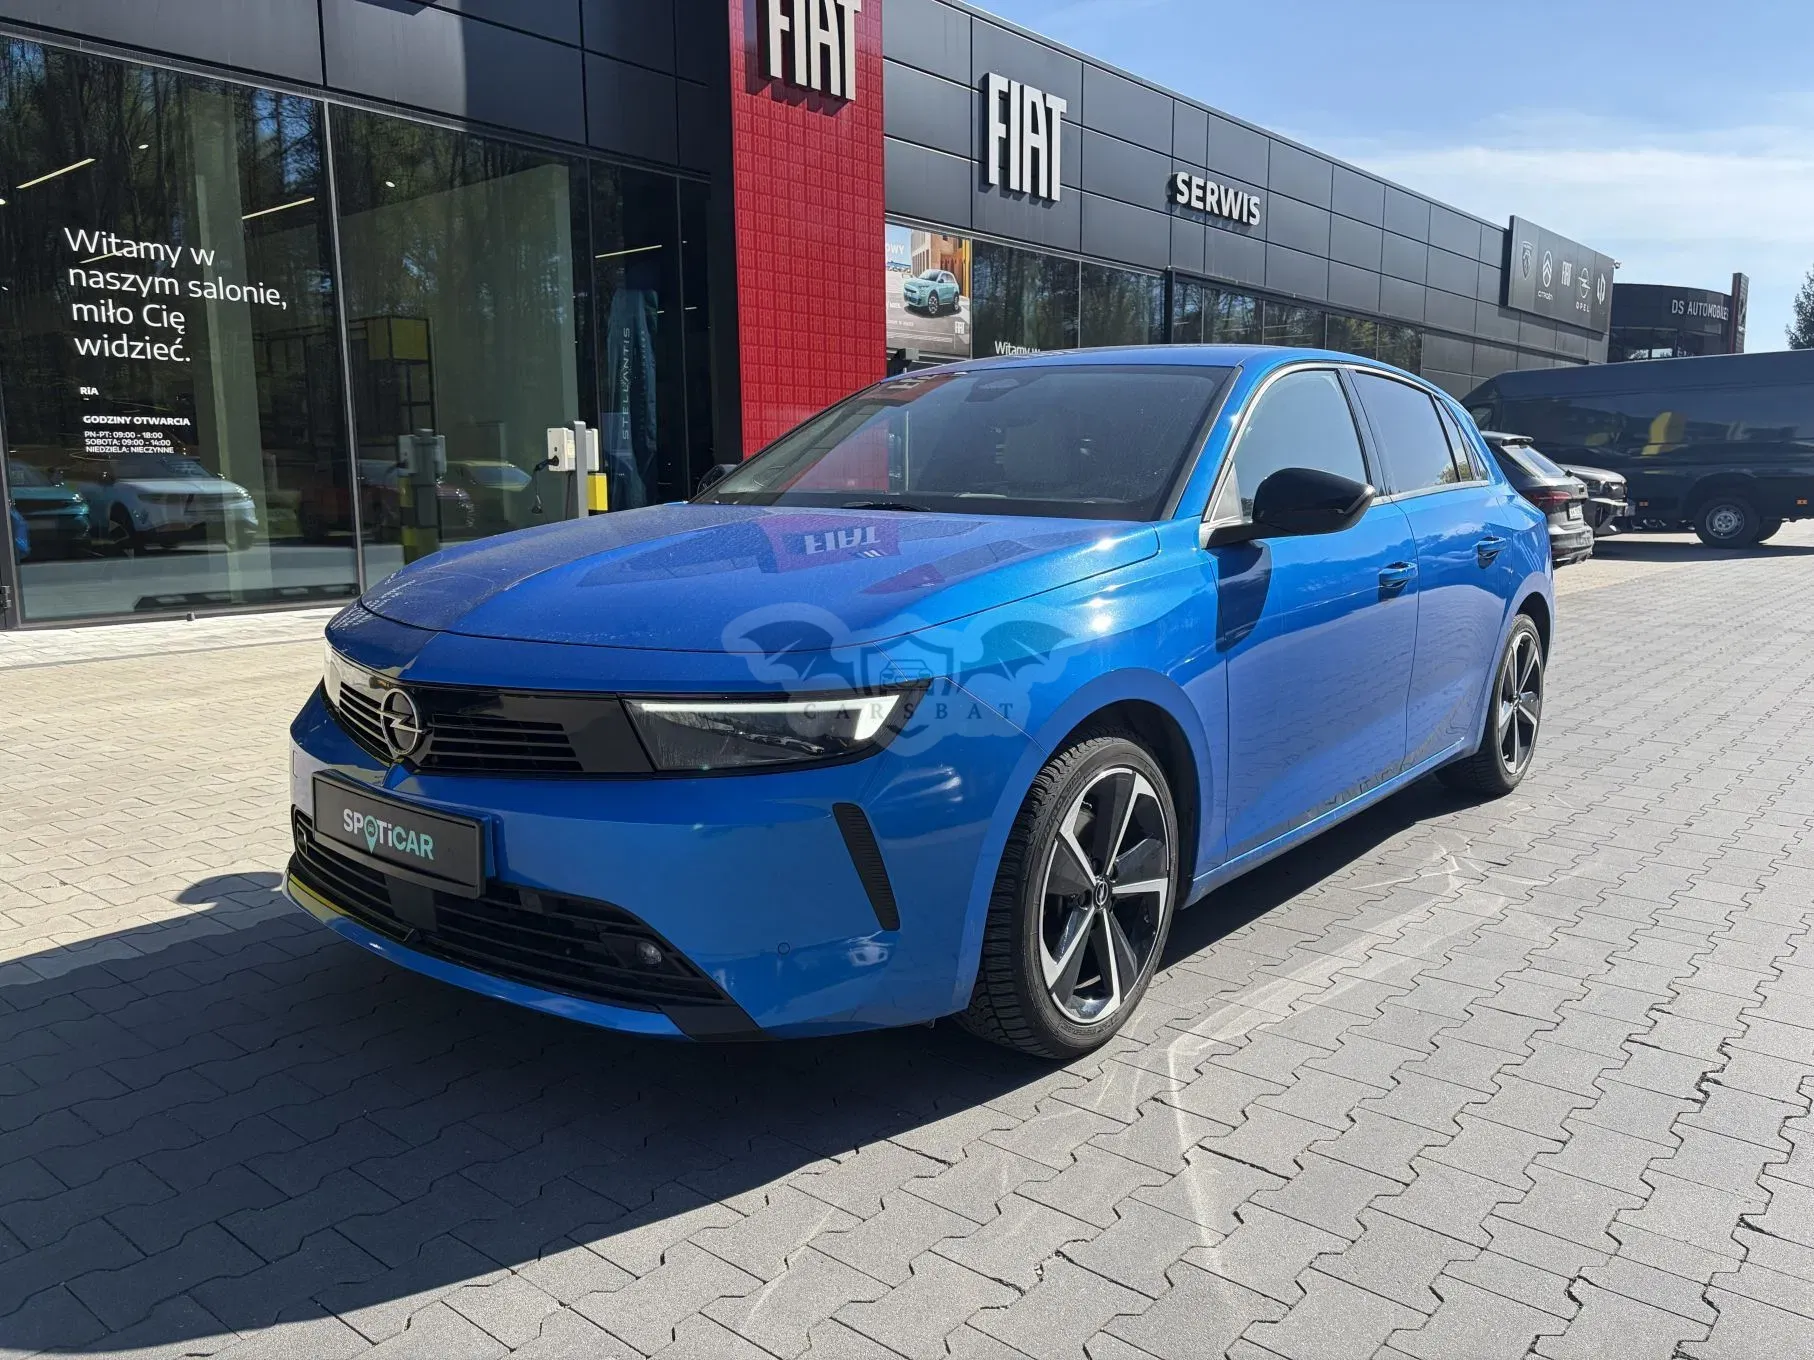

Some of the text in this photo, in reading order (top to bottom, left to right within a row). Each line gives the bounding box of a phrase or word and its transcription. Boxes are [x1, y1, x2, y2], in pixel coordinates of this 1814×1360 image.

[769, 0, 861, 101] FIAT
[988, 72, 1067, 201] FIAT
[1176, 171, 1261, 226] SERWIS
[64, 227, 215, 268] Witamy w
[69, 267, 287, 310] naszym salonie,
[72, 299, 186, 334] miło Cię
[1575, 301, 1590, 313] OPEL
[1671, 299, 1685, 314] DS
[74, 333, 191, 363] widzieć.
[622, 327, 631, 440] STELLANTIS
[83, 415, 191, 426] GODZINY OTWARCIA
[113, 431, 136, 439] 09:00
[85, 438, 121, 446] SOBOTA:
[130, 446, 175, 454] NIECZYNNE
